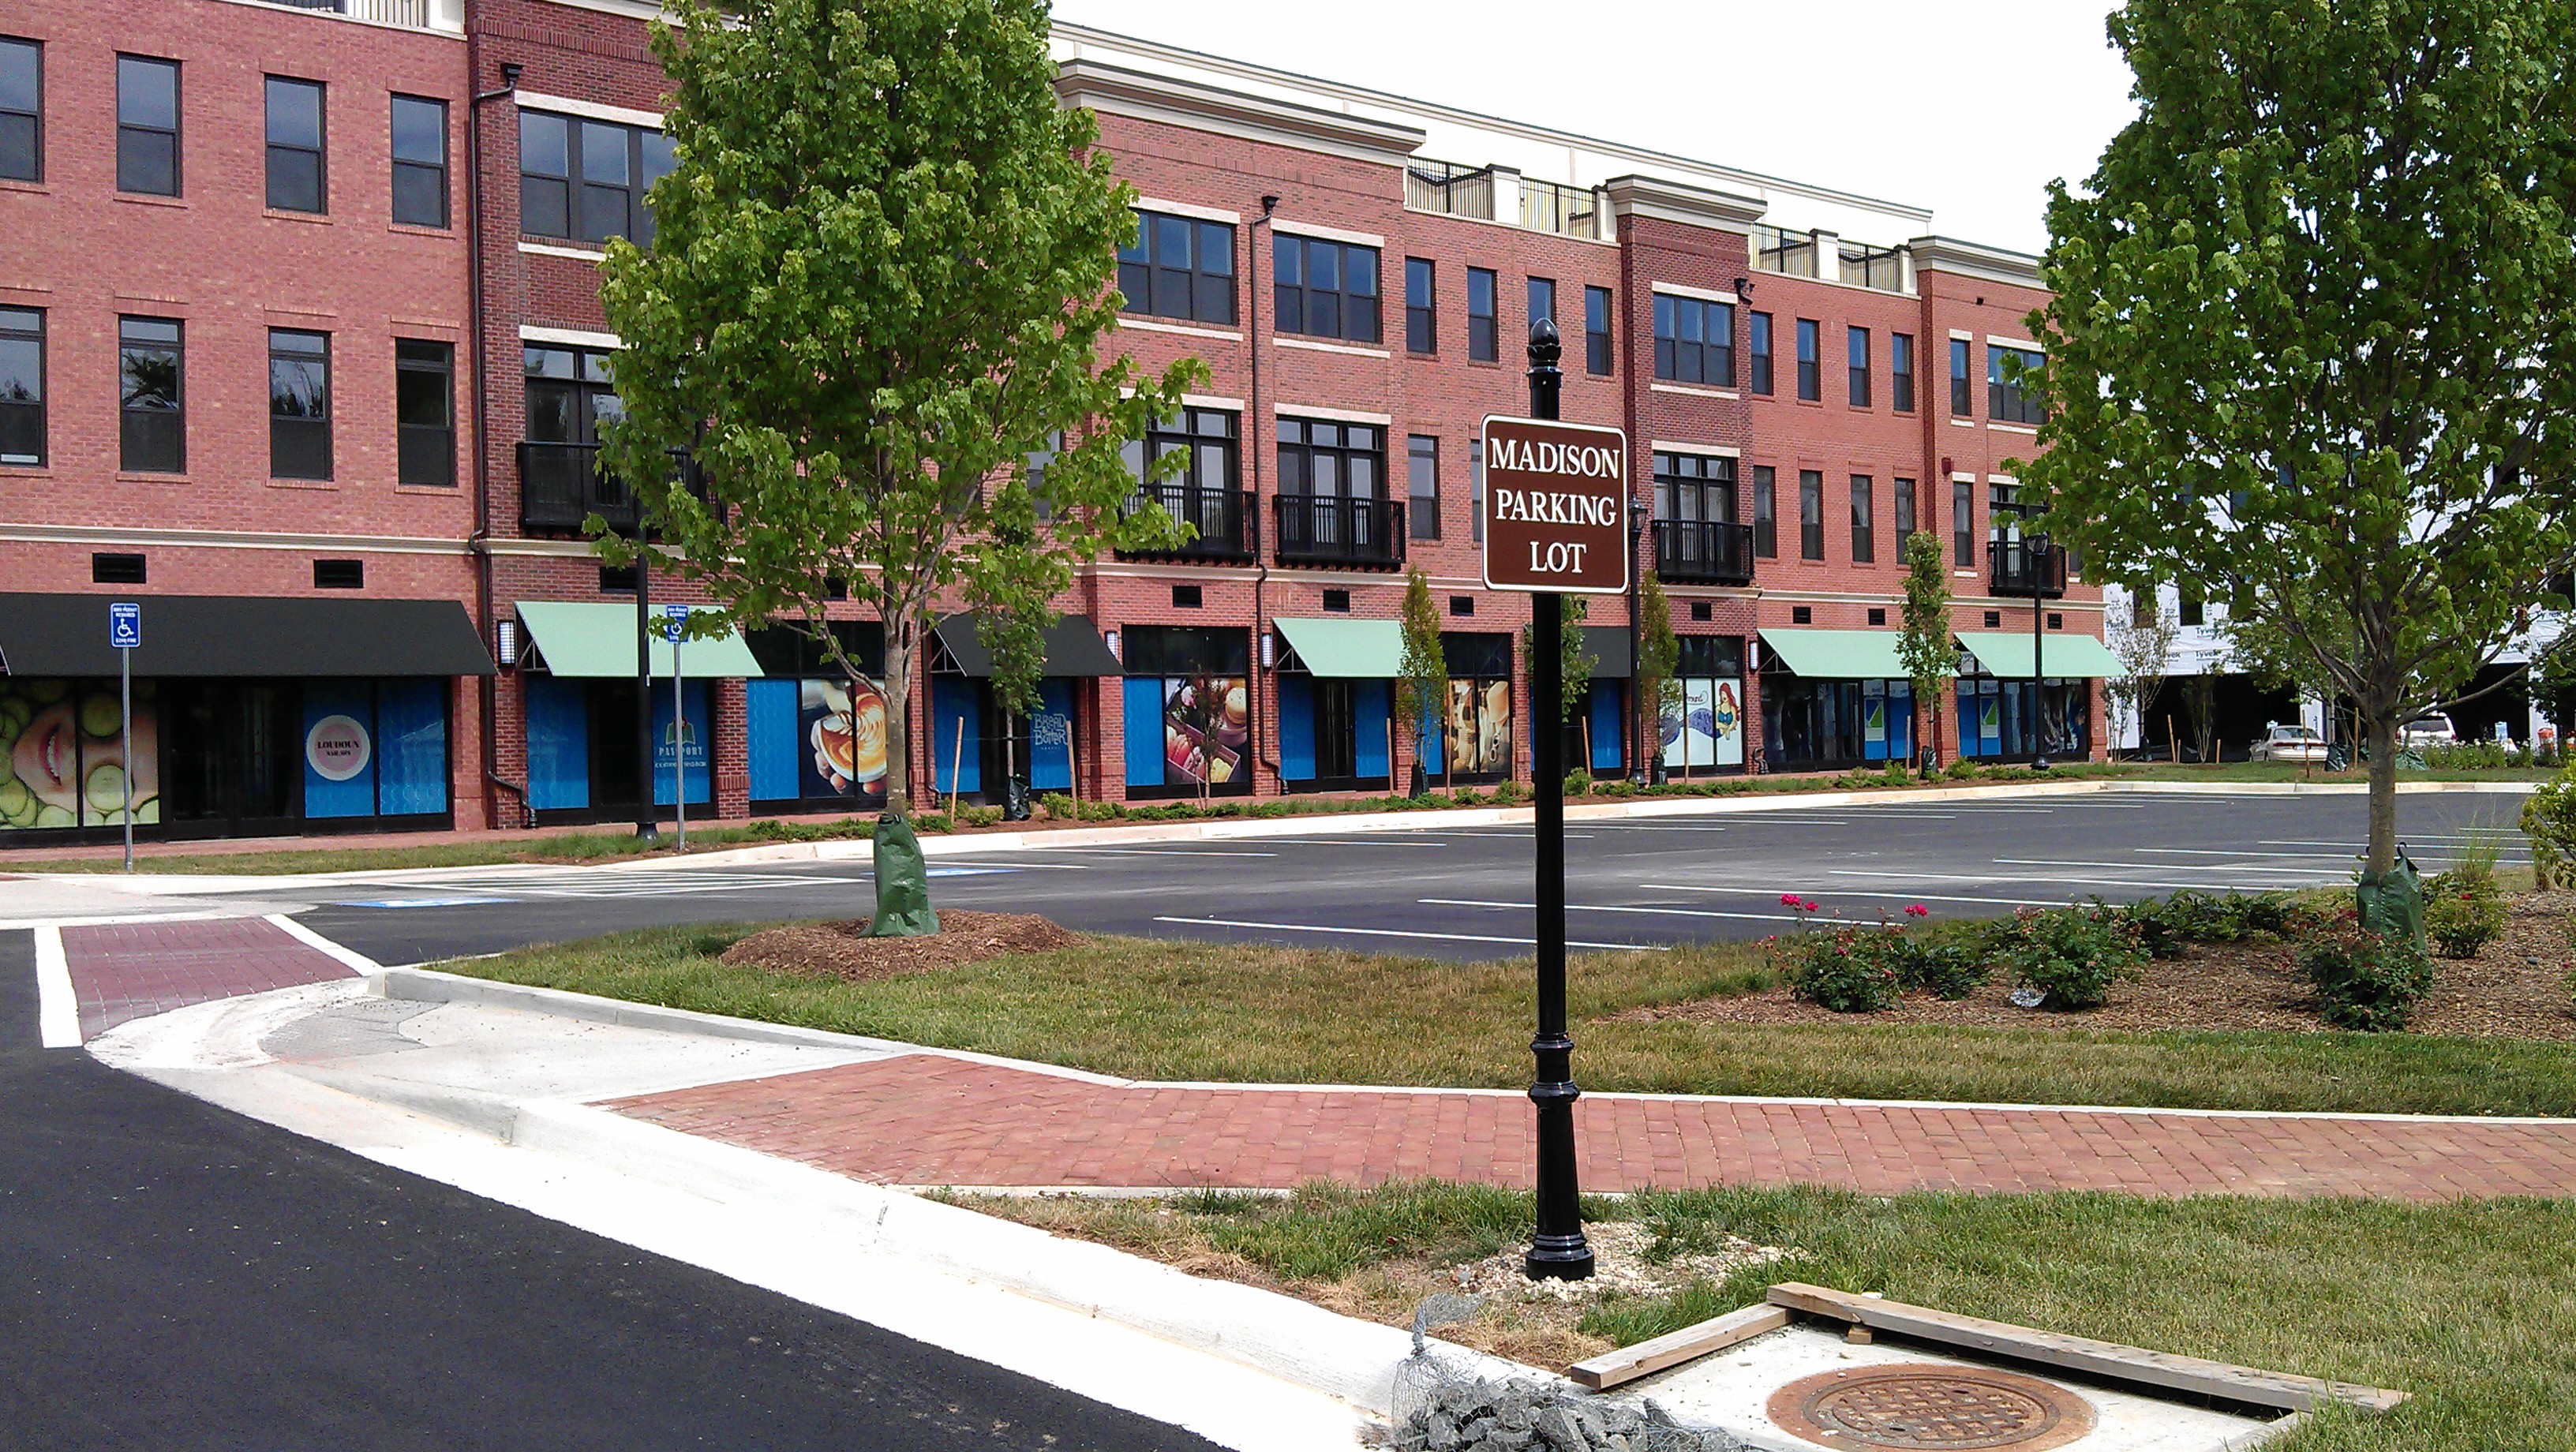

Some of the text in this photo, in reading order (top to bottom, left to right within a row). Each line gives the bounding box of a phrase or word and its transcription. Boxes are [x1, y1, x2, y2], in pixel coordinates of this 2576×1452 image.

[1490, 438, 1619, 479] MADISON
[1496, 488, 1616, 526] PARKING
[1530, 541, 1586, 573] LOT
[2195, 627, 2218, 636] Tyve
[659, 747, 702, 756] PASPORT
